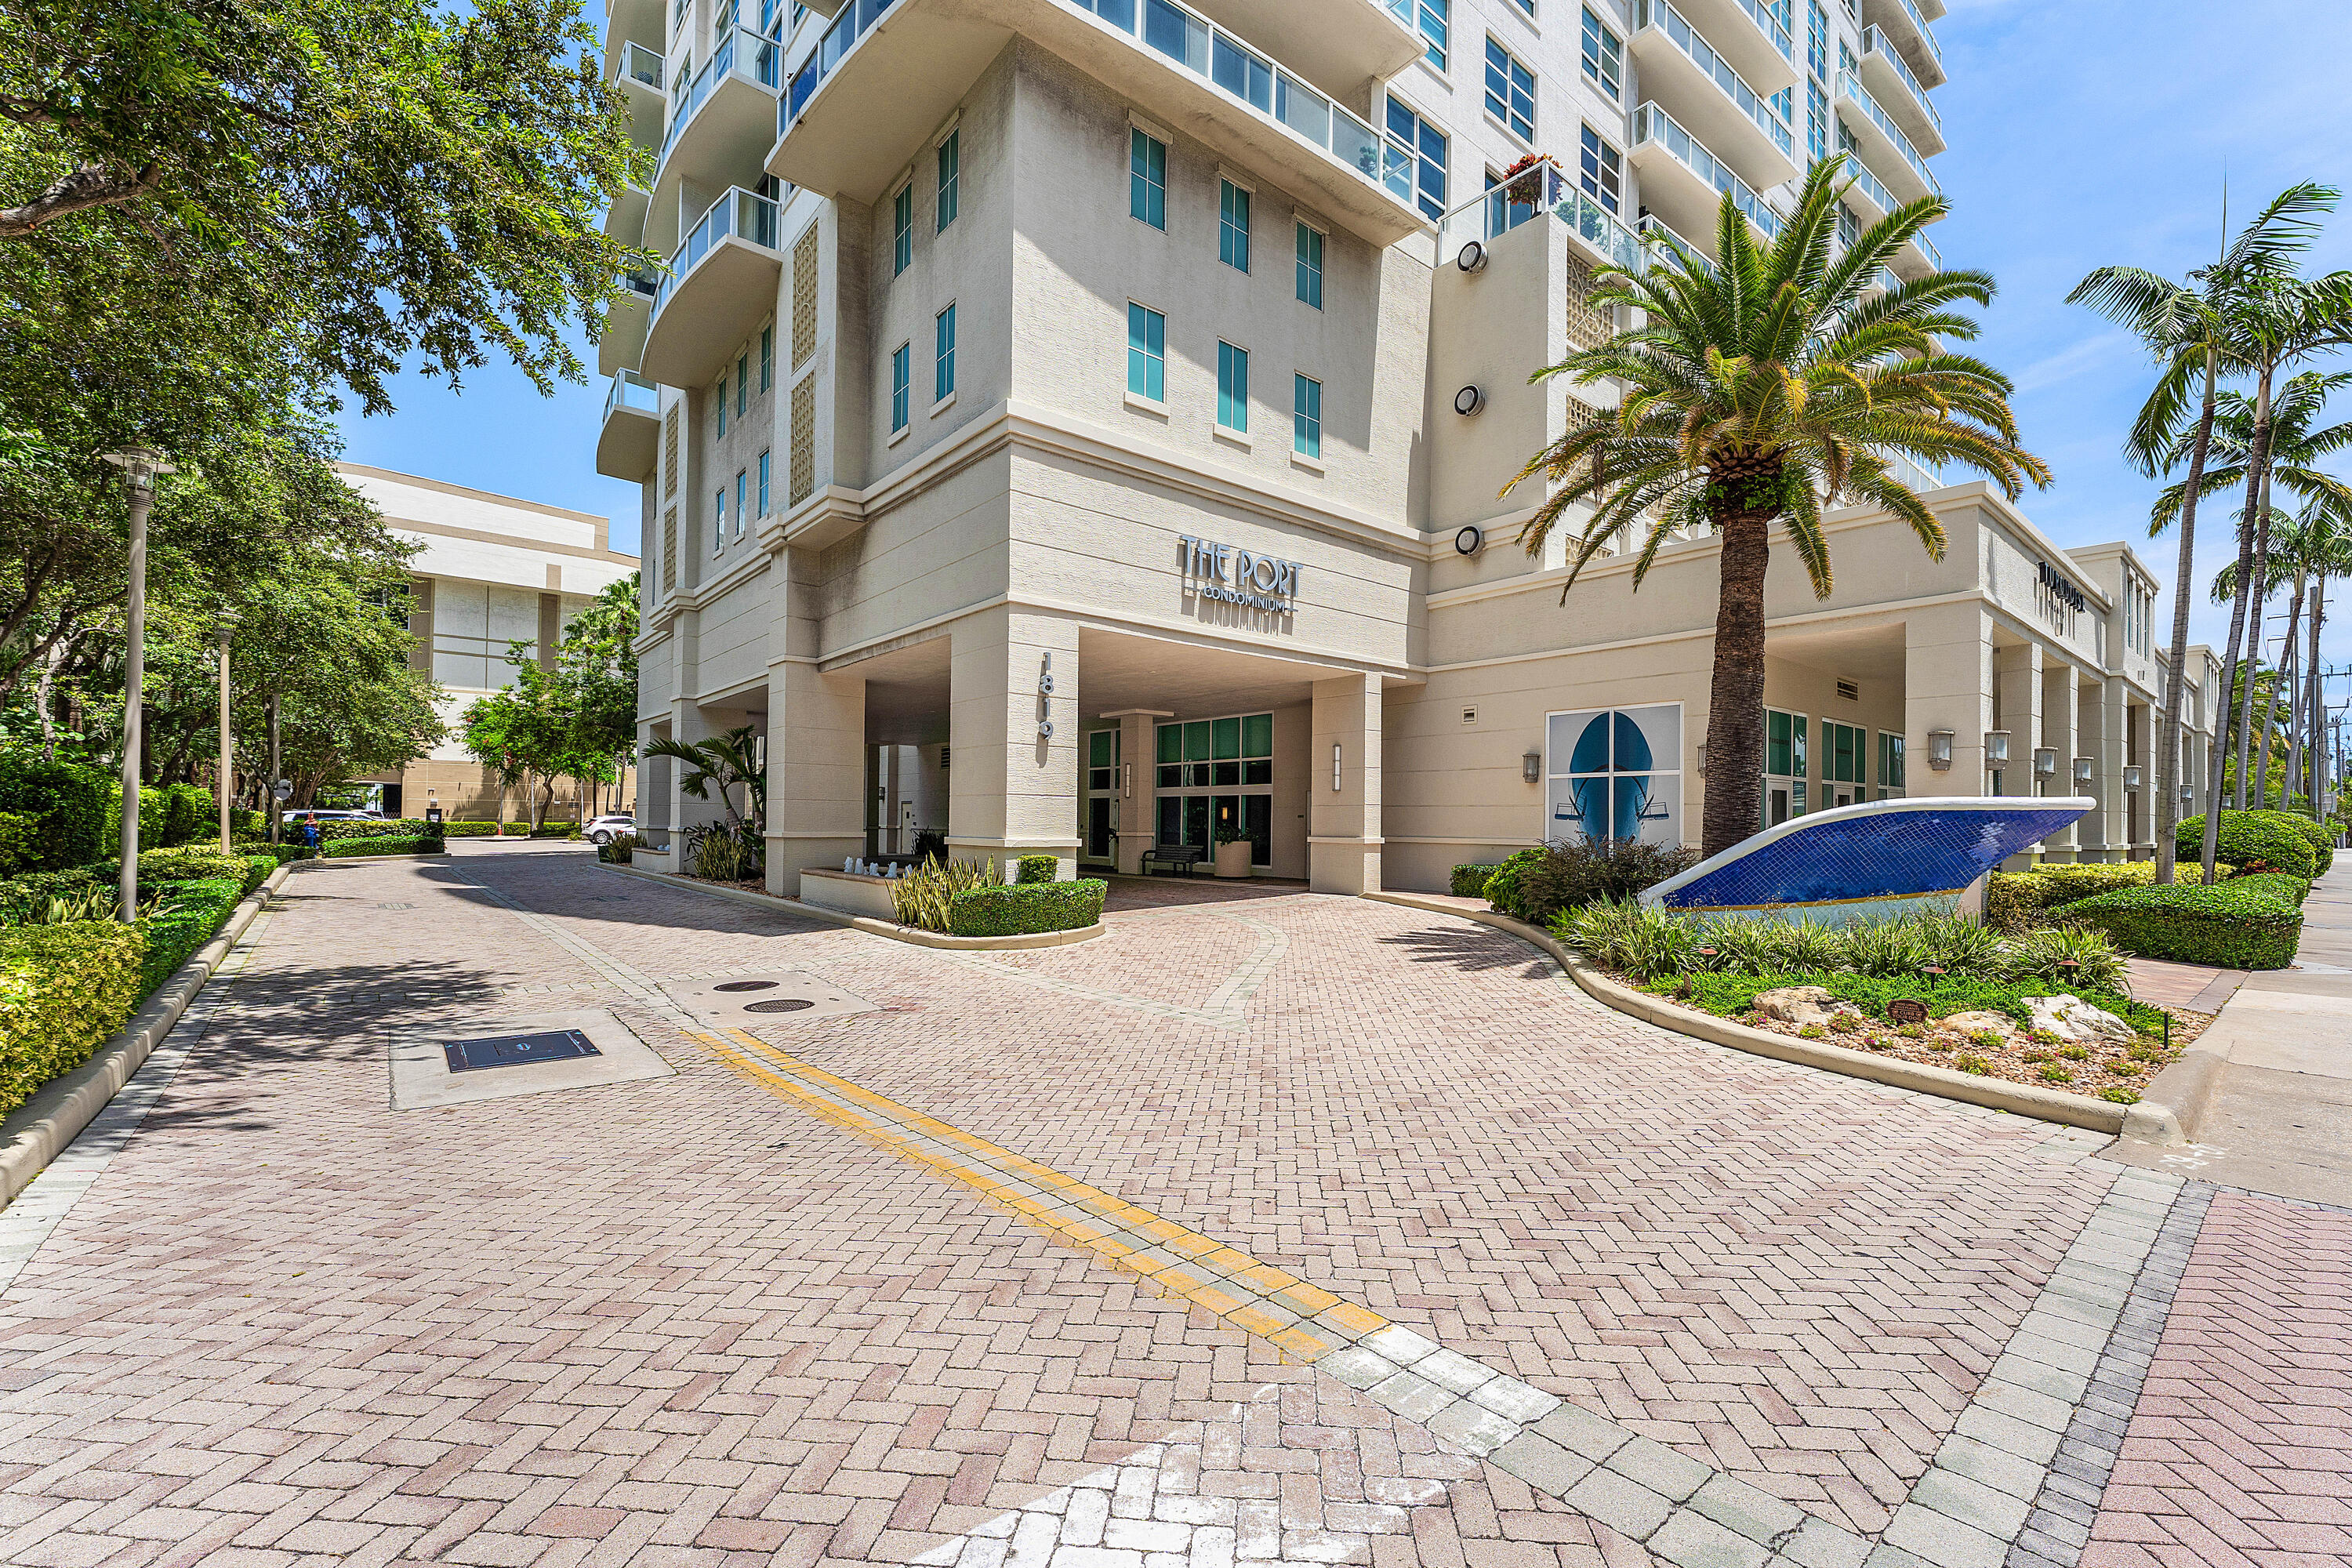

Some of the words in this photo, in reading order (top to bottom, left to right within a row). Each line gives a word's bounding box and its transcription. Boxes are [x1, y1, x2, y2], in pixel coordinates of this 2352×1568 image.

[1179, 535, 1230, 582] THE
[1239, 550, 1303, 597] PORT
[1203, 586, 1285, 612] CONDOMINIUM
[1040, 652, 1054, 740] 1819
